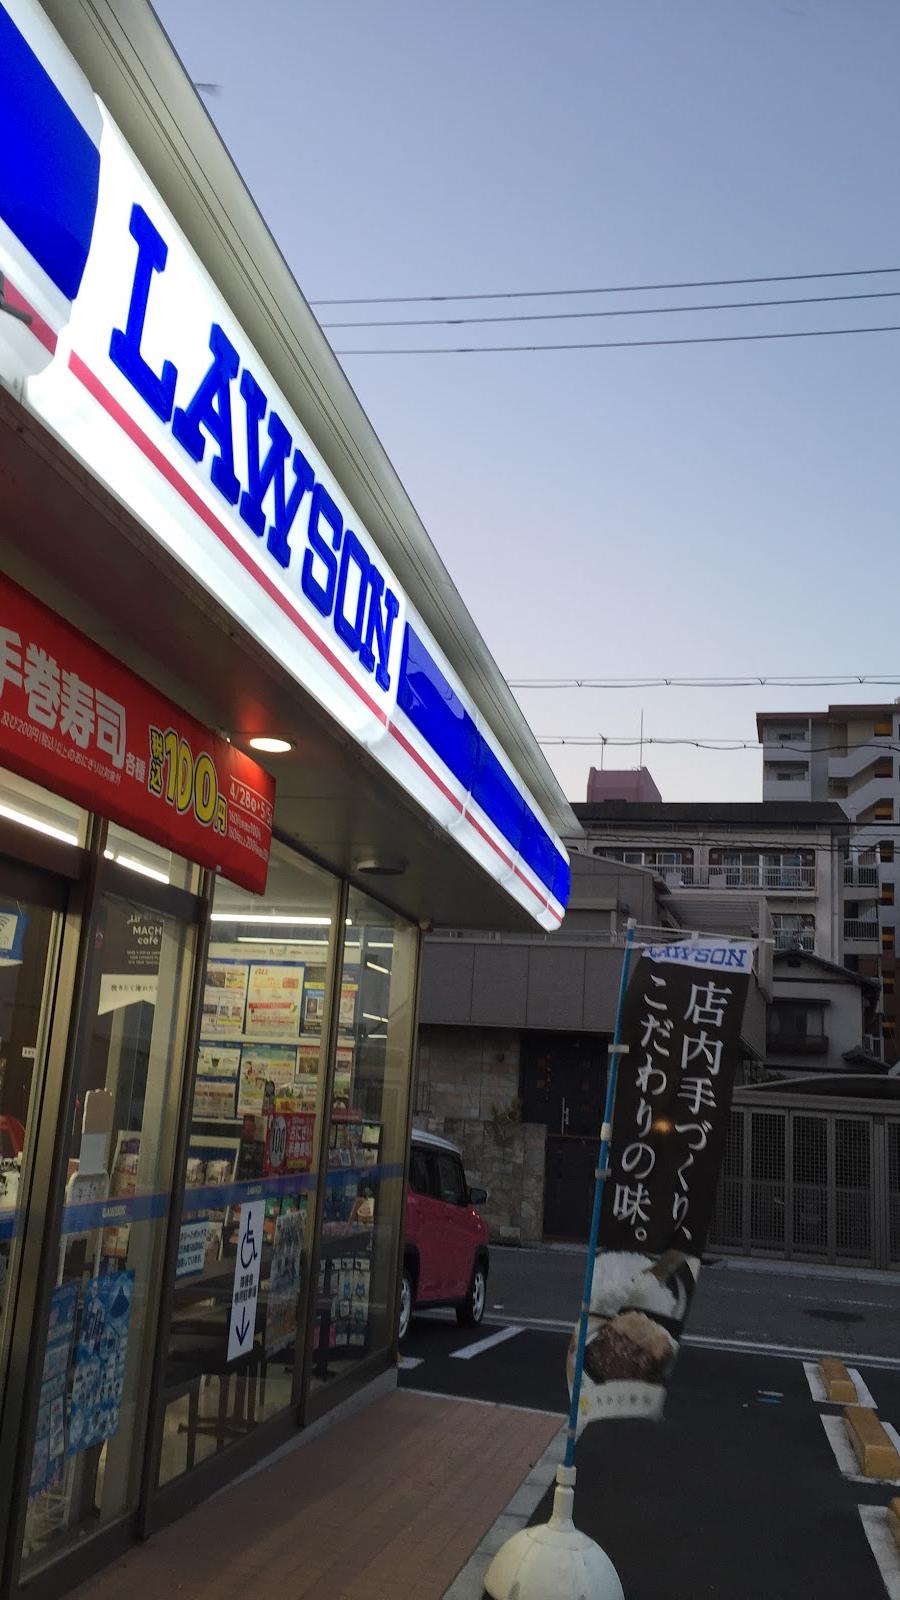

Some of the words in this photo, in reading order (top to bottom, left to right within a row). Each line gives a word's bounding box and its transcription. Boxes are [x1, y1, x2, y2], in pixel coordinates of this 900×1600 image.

[109, 203, 399, 692] LAWSON
[132, 926, 162, 936] MACH
[612, 973, 675, 1242] こだわりの味。
[675, 980, 734, 1242] 店内手づくり、
